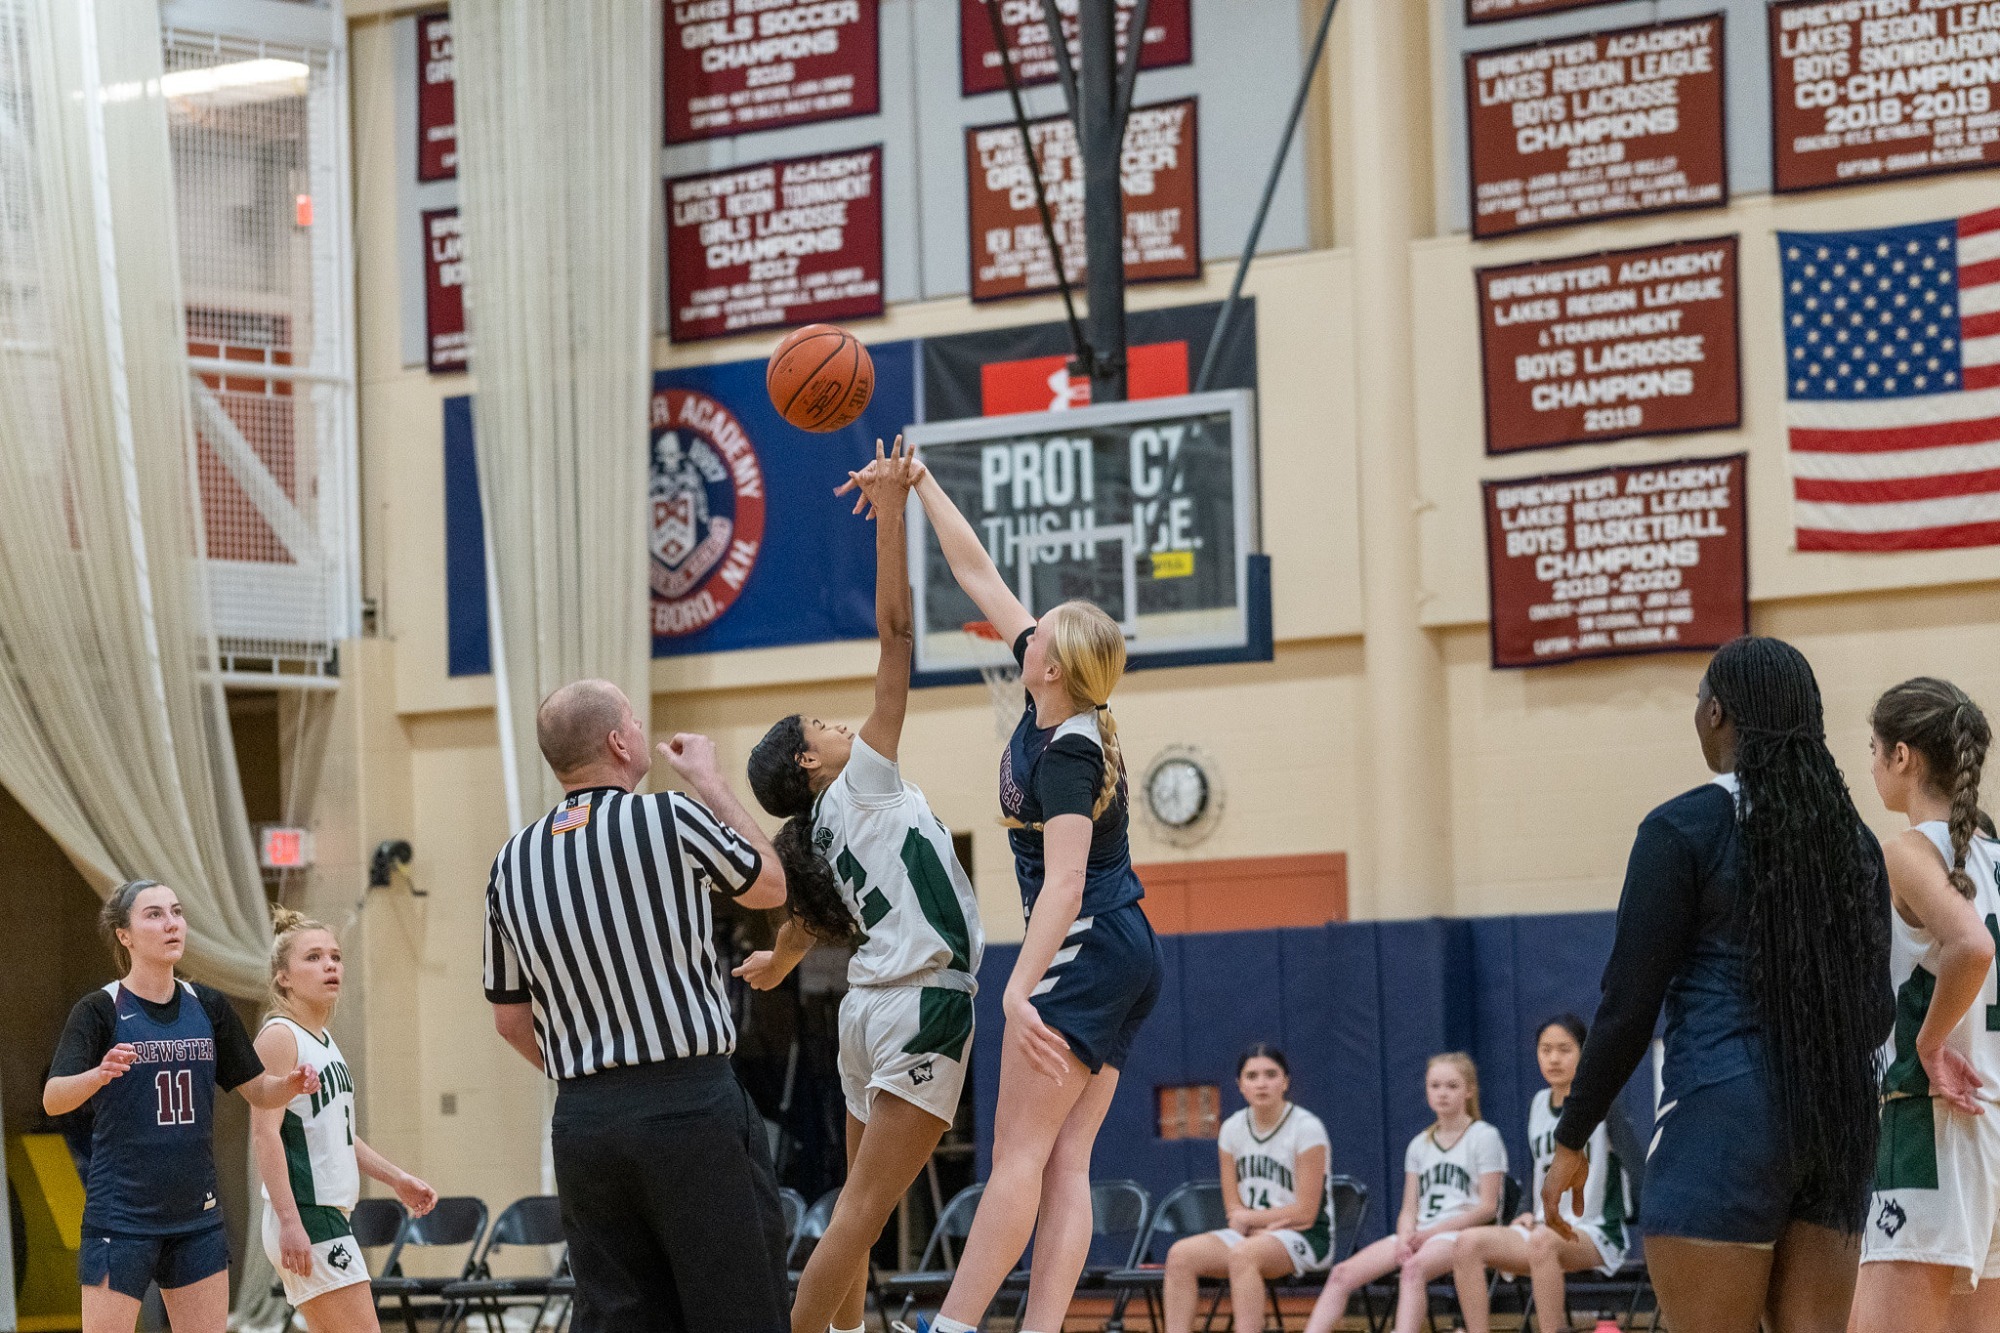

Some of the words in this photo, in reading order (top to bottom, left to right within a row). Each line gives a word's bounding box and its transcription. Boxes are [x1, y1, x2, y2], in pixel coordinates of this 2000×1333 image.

[758, 1, 859, 37] SOCCER
[1780, 0, 1911, 31] BREWSTER
[1780, 24, 1851, 58] LAKES
[1860, 12, 1937, 45] REGION
[702, 28, 838, 73] CHAMPIONS
[1477, 41, 1598, 79] BREWSTER
[1606, 24, 1712, 58] ACADEMY
[1793, 52, 1850, 83] BOYS
[1479, 71, 1546, 106] LAKES
[1552, 61, 1625, 93] REGION
[1631, 46, 1713, 81] LEAGUE
[1512, 95, 1567, 127] BOYS
[1572, 78, 1680, 118] LACROSSE
[1825, 87, 1991, 132] 2018-2019
[1517, 106, 1679, 154] CHAMPIONS
[673, 167, 775, 202] BREWSTER
[782, 153, 873, 185] ACADEMY
[674, 197, 720, 227] LAKES
[701, 216, 750, 247] GIRLS
[755, 201, 848, 237] LACROSSE
[706, 226, 843, 270] CHAMPIONS
[1489, 266, 1611, 300] BREWSTER
[1618, 251, 1724, 284] ACADEMY
[1494, 299, 1560, 326] LAKES
[1566, 289, 1637, 316] REGION
[1643, 277, 1723, 307] LEAGUE
[1552, 310, 1683, 345] TOURNAMENT
[1515, 350, 1577, 381] BOYS
[1584, 335, 1704, 373] LACROSSE
[1532, 368, 1694, 411] CHAMPIONS
[678, 396, 763, 496] ACADEMY
[1496, 476, 1617, 509] BREWSTER
[1625, 465, 1731, 495] ACADEMY
[1501, 504, 1567, 531] LAKES
[1573, 496, 1644, 522] REGION
[1651, 487, 1729, 514] LEAGUE
[980, 511, 1061, 568] THIS
[1506, 526, 1567, 558] BOYS
[1574, 511, 1727, 550] BASKETBALL
[1536, 540, 1699, 581] CHAMPIONS
[131, 1038, 213, 1064] REWSTER
[155, 1069, 195, 1126] 11
[1426, 1194, 1445, 1218] 5
